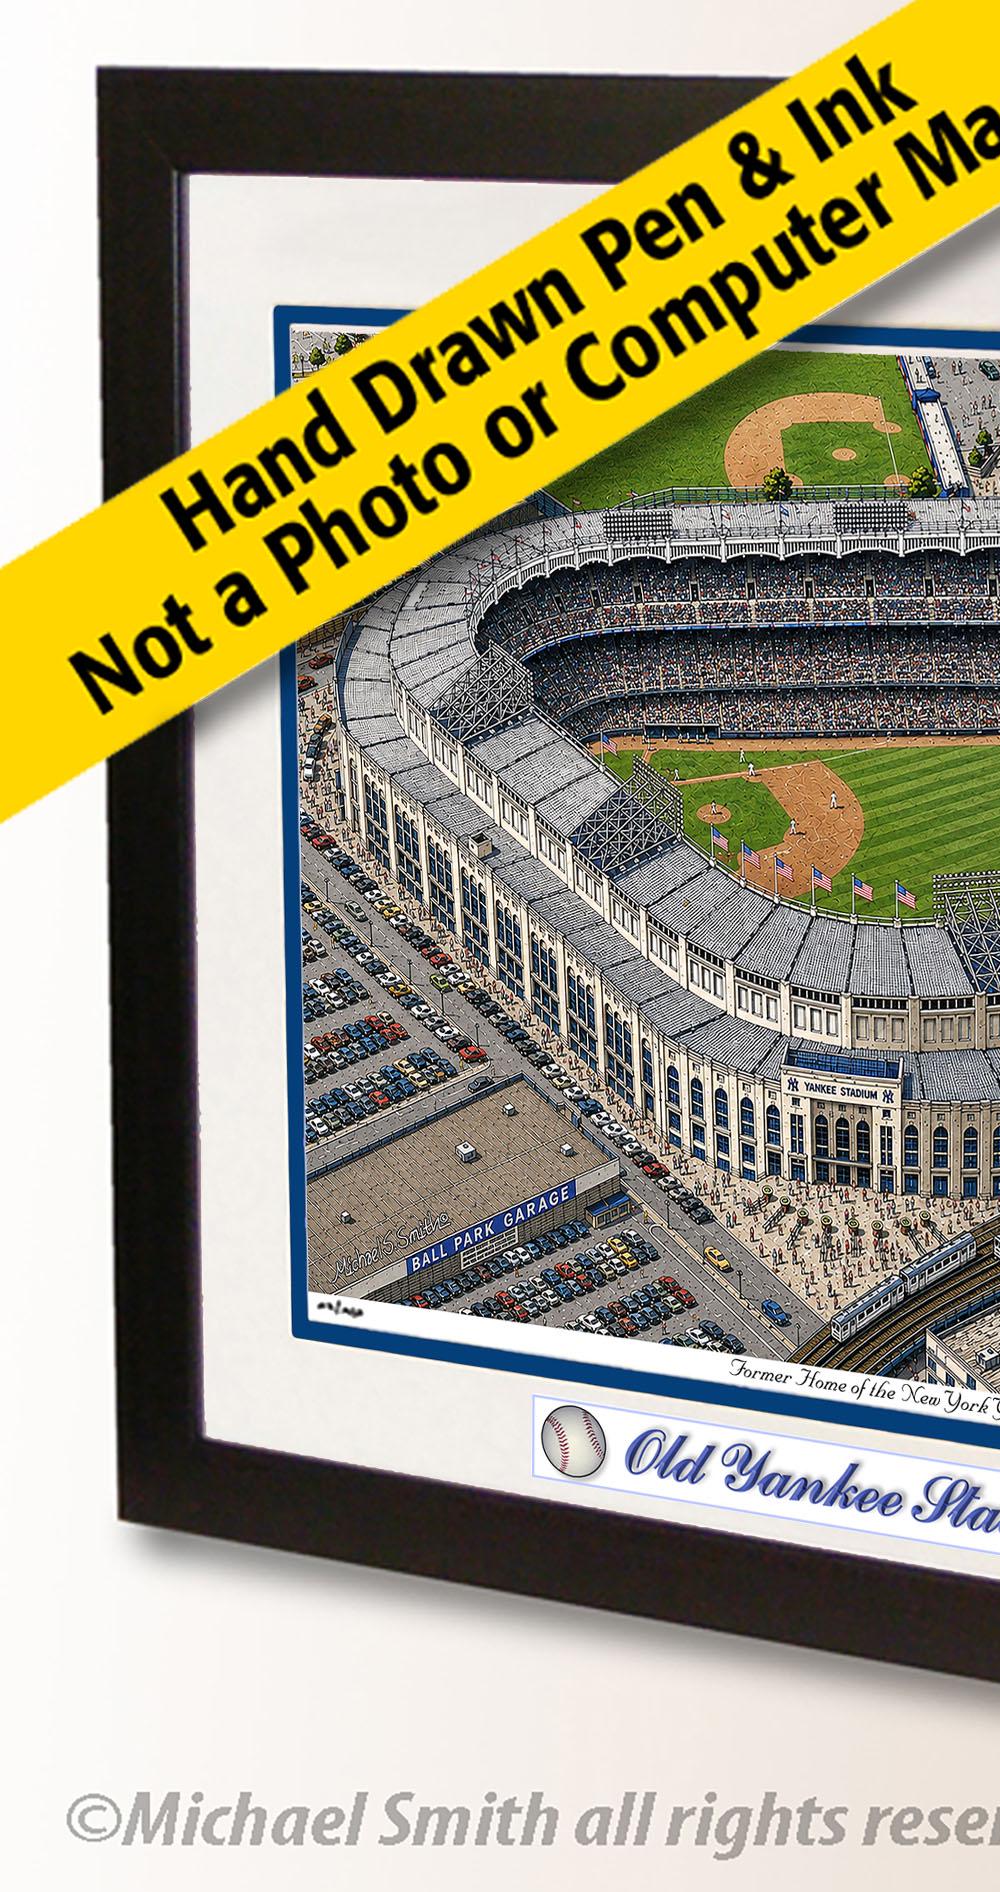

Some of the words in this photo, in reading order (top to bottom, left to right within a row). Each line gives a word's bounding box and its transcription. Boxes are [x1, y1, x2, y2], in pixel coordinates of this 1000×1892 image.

[804, 1081, 837, 1096] YANKEE
[840, 1086, 878, 1100] STADIUM
[411, 1244, 448, 1272] BALL
[454, 1219, 495, 1251] PARK
[503, 1185, 570, 1228] GARAGE
[331, 1236, 382, 1284] Michael
[728, 1358, 792, 1384] Former
[796, 1366, 847, 1395] Home
[851, 1379, 870, 1400] of
[872, 1379, 896, 1401] the
[901, 1383, 941, 1407] New
[943, 1390, 989, 1414] York
[624, 1427, 713, 1484] Old
[721, 1442, 904, 1518] Yankee
